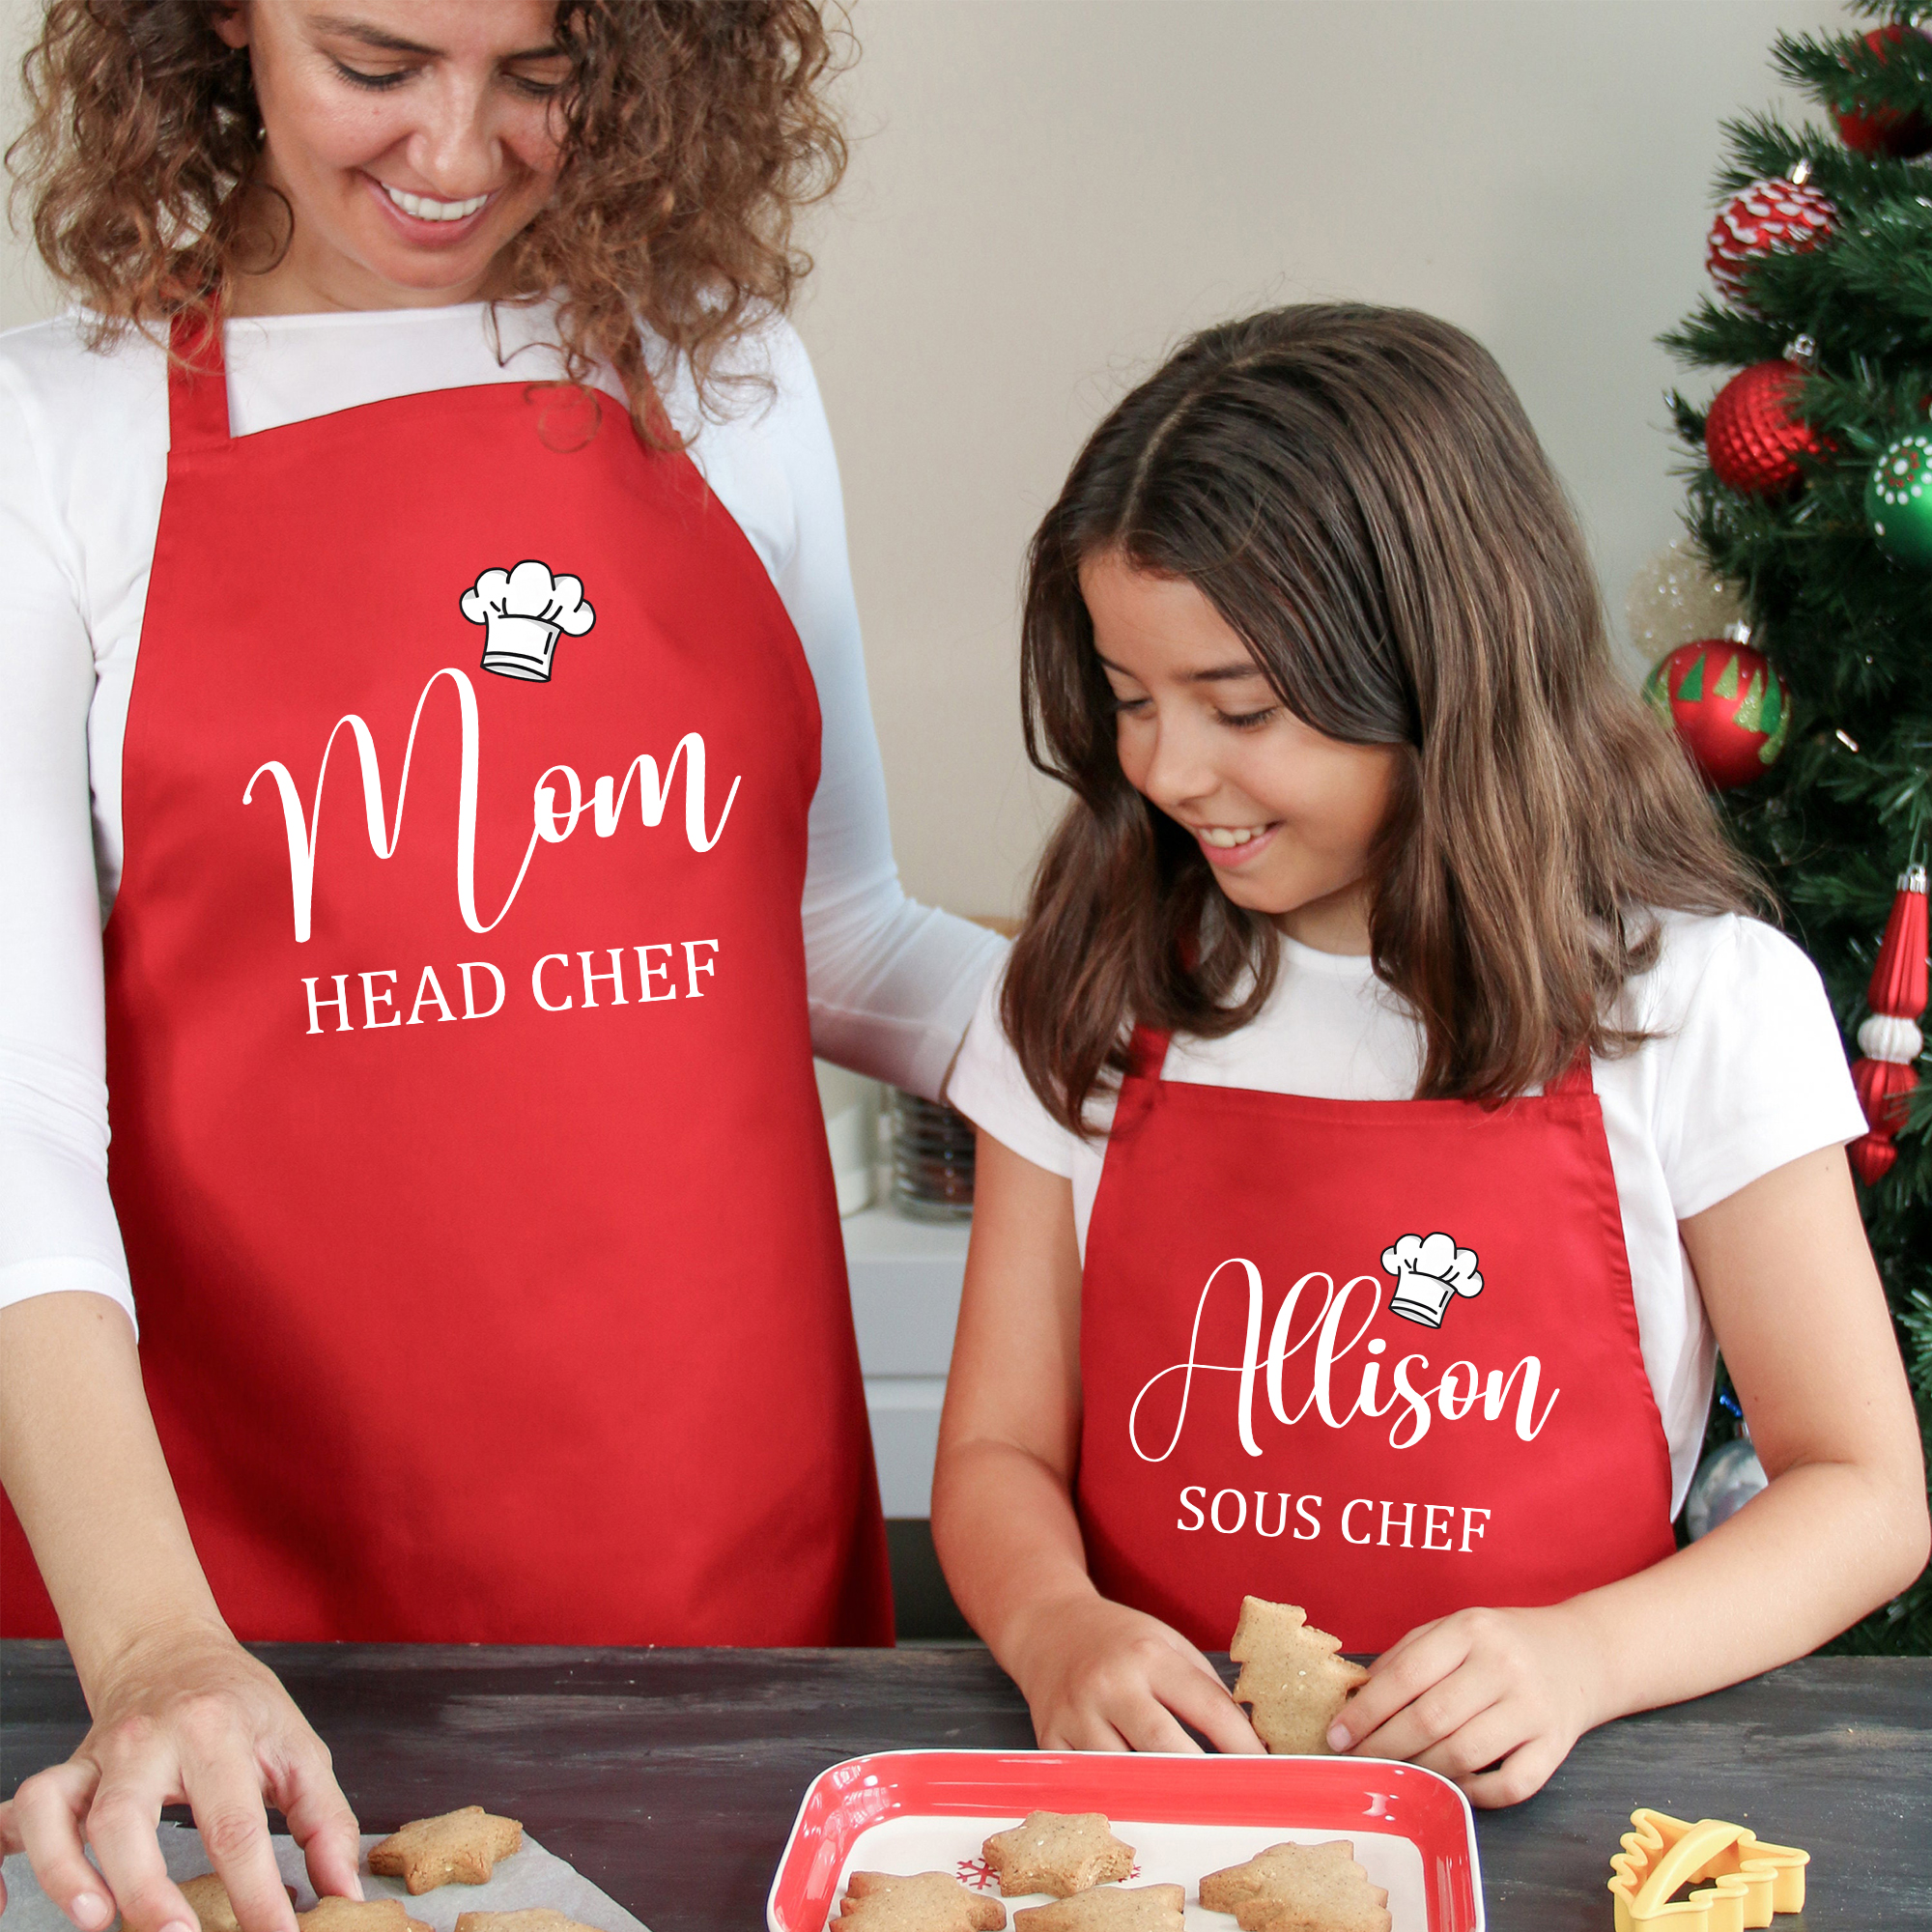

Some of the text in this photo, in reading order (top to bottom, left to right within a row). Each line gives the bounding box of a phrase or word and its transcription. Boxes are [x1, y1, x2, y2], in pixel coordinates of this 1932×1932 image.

[242, 667, 742, 944] Mom
[300, 938, 720, 1035] HEAD CHEF
[1128, 1258, 1561, 1463] Allison
[1177, 1486, 1492, 1553] SOUS CHEF
